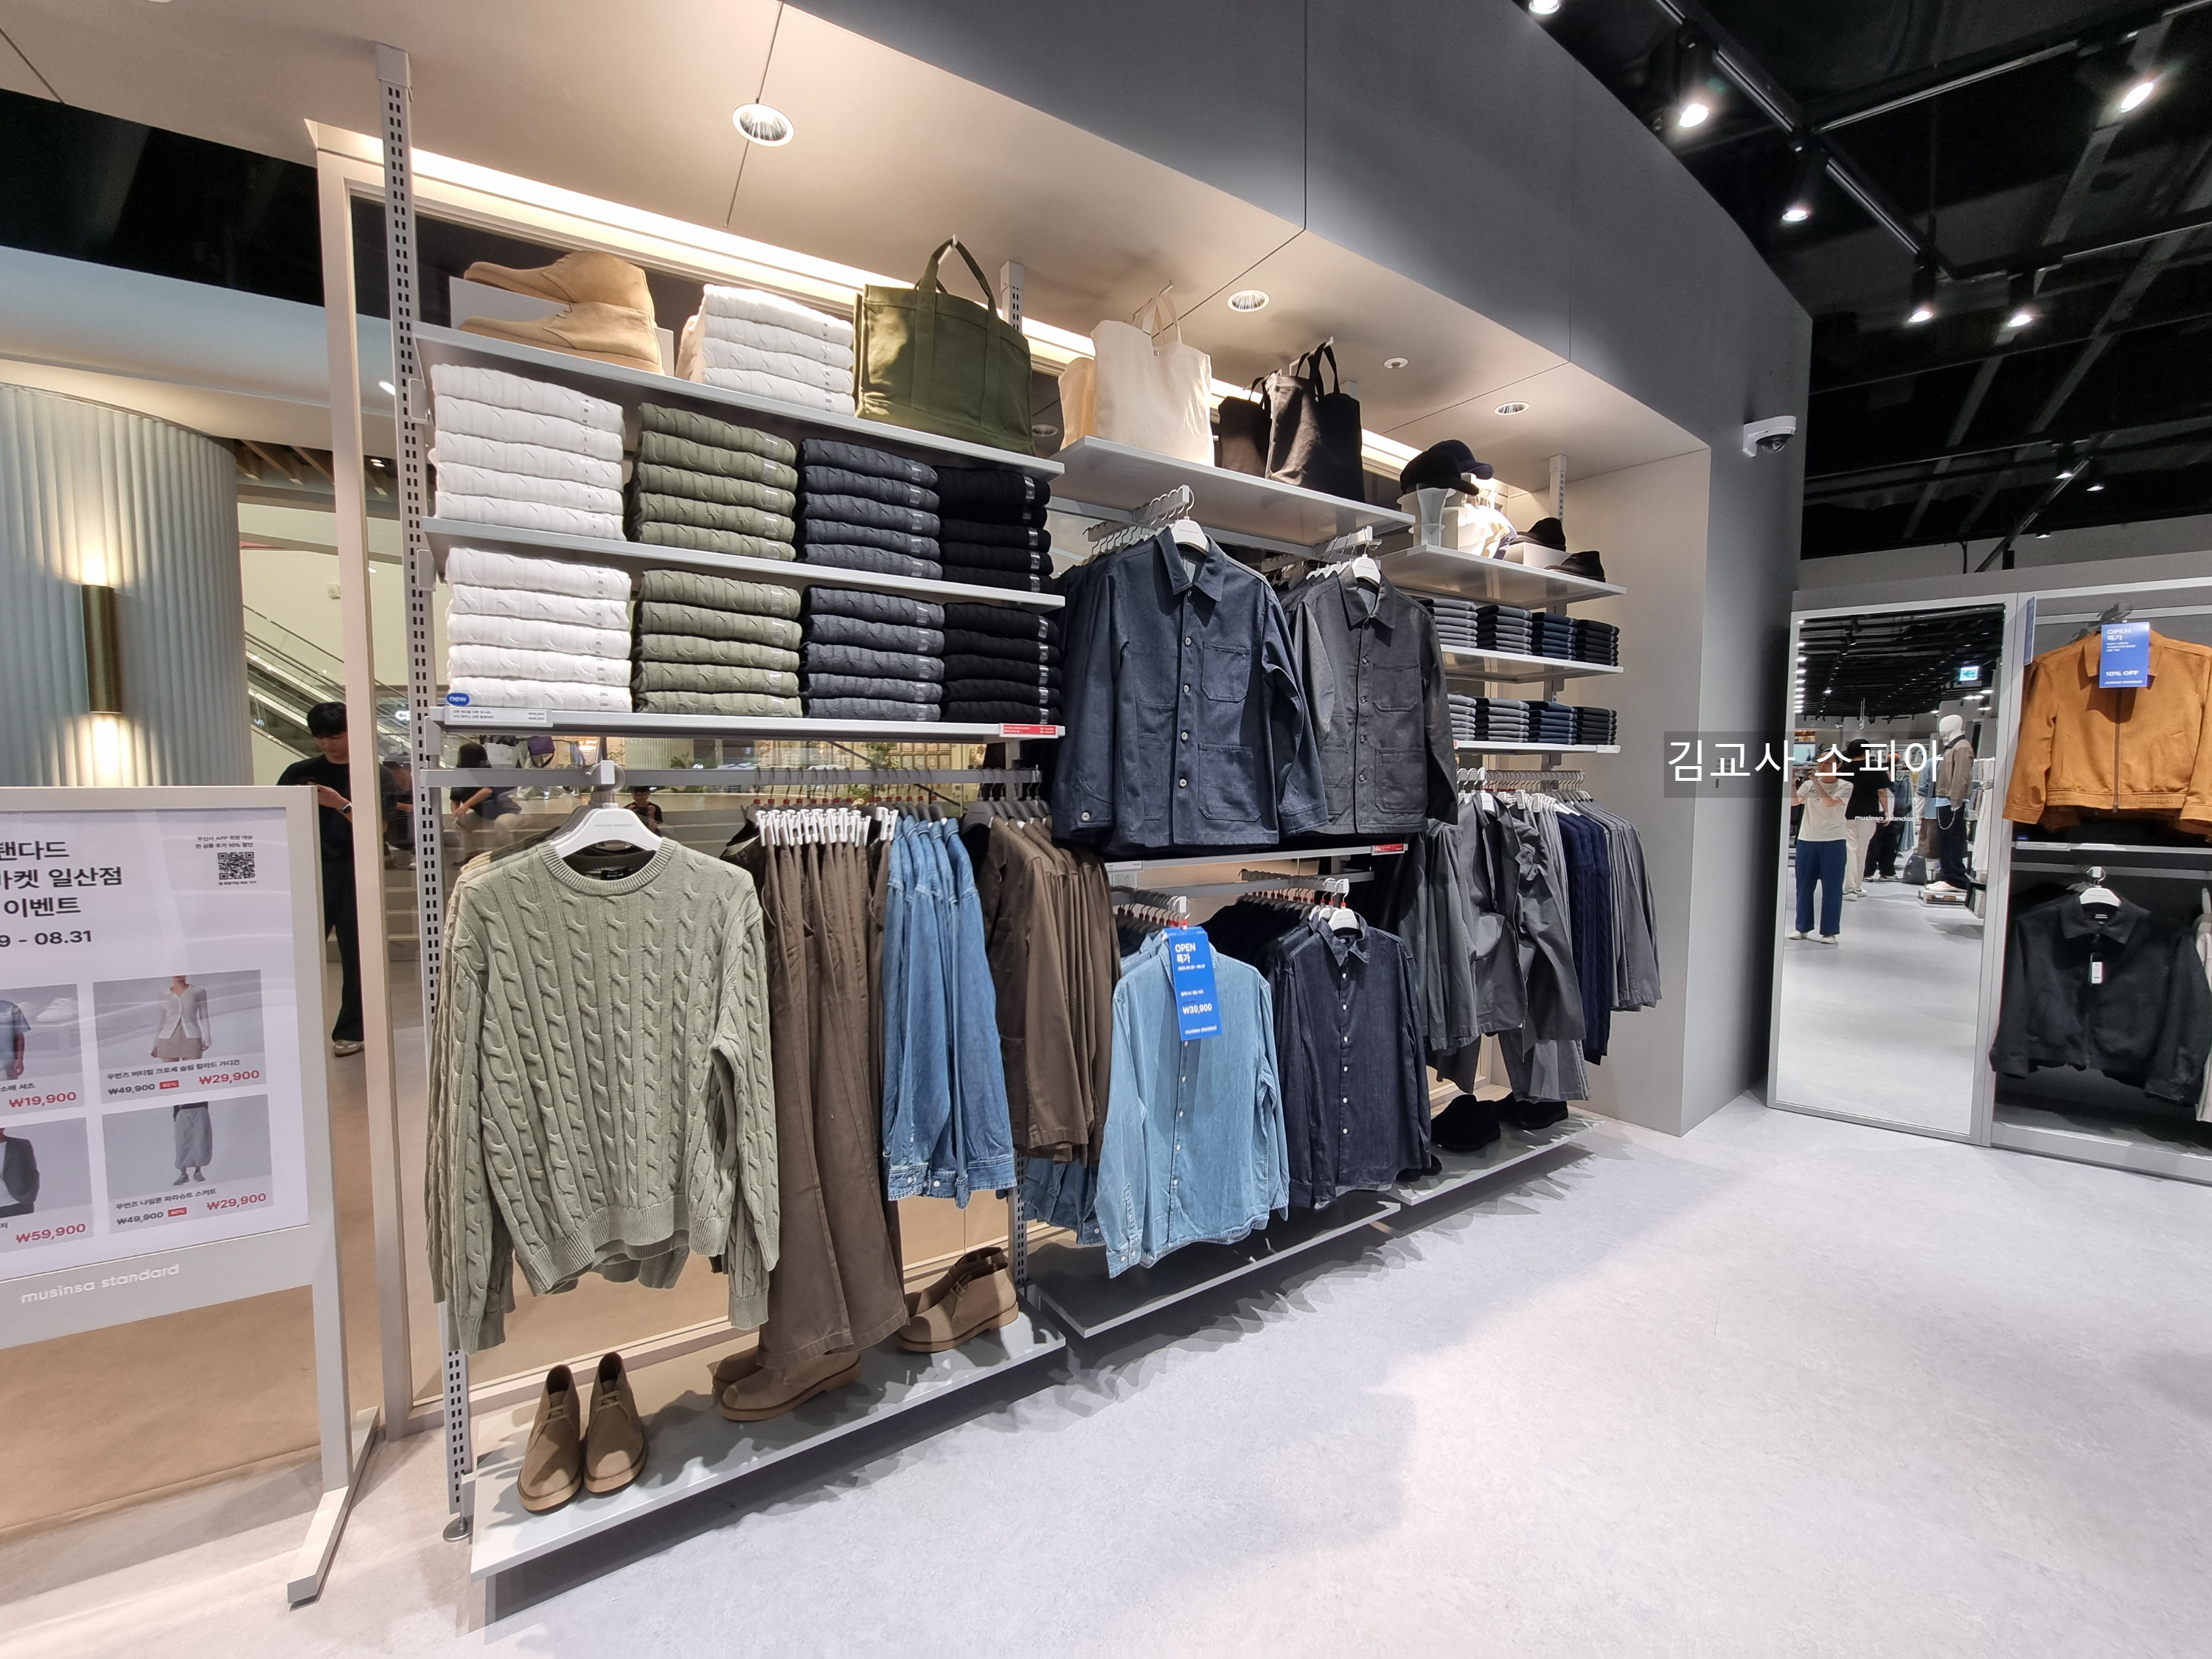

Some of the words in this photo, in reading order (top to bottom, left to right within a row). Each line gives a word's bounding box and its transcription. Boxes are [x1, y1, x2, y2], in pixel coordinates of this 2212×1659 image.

[49, 866, 122, 888] 일산점
[4, 897, 81, 918] 이벤트
[35, 930, 91, 945] 08.31
[1175, 942, 1196, 953] OPEN
[198, 1070, 260, 1085] ₩29,900
[9, 1091, 76, 1107] ₩19,900
[116, 1201, 139, 1210] 우먼즈
[140, 1197, 162, 1206] 나일론
[164, 1192, 193, 1202] 파라슈트
[195, 1188, 217, 1197] 스커트
[206, 1193, 267, 1211] ₩29,900
[15, 1223, 86, 1243] ₩59,900
[21, 1281, 96, 1304] musinsa
[101, 1263, 180, 1288] standard
